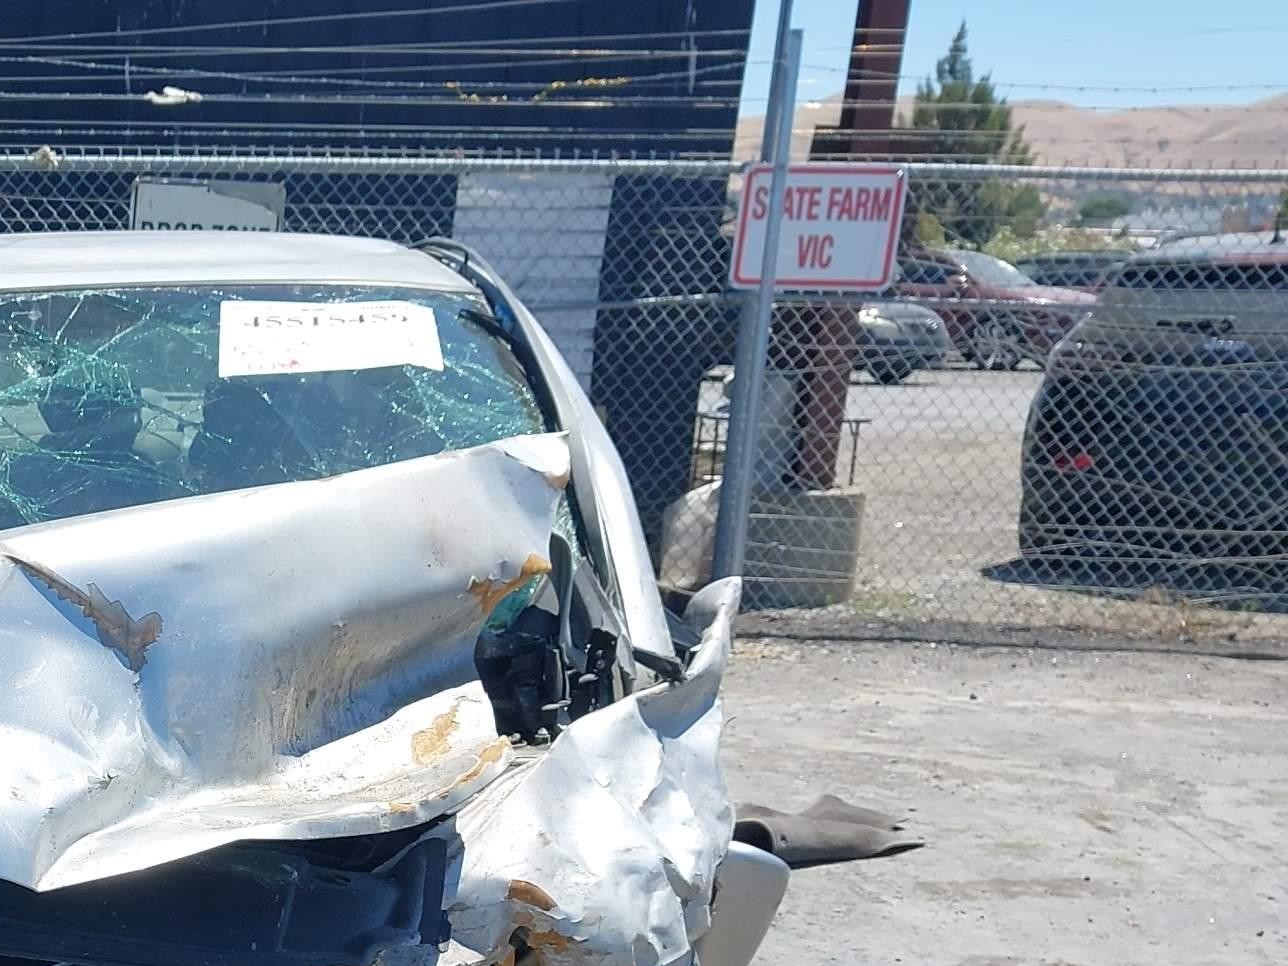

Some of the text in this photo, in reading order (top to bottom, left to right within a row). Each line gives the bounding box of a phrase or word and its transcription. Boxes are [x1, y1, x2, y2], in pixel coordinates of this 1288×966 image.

[752, 185, 893, 222] SATE FARM
[797, 233, 835, 269] VIC
